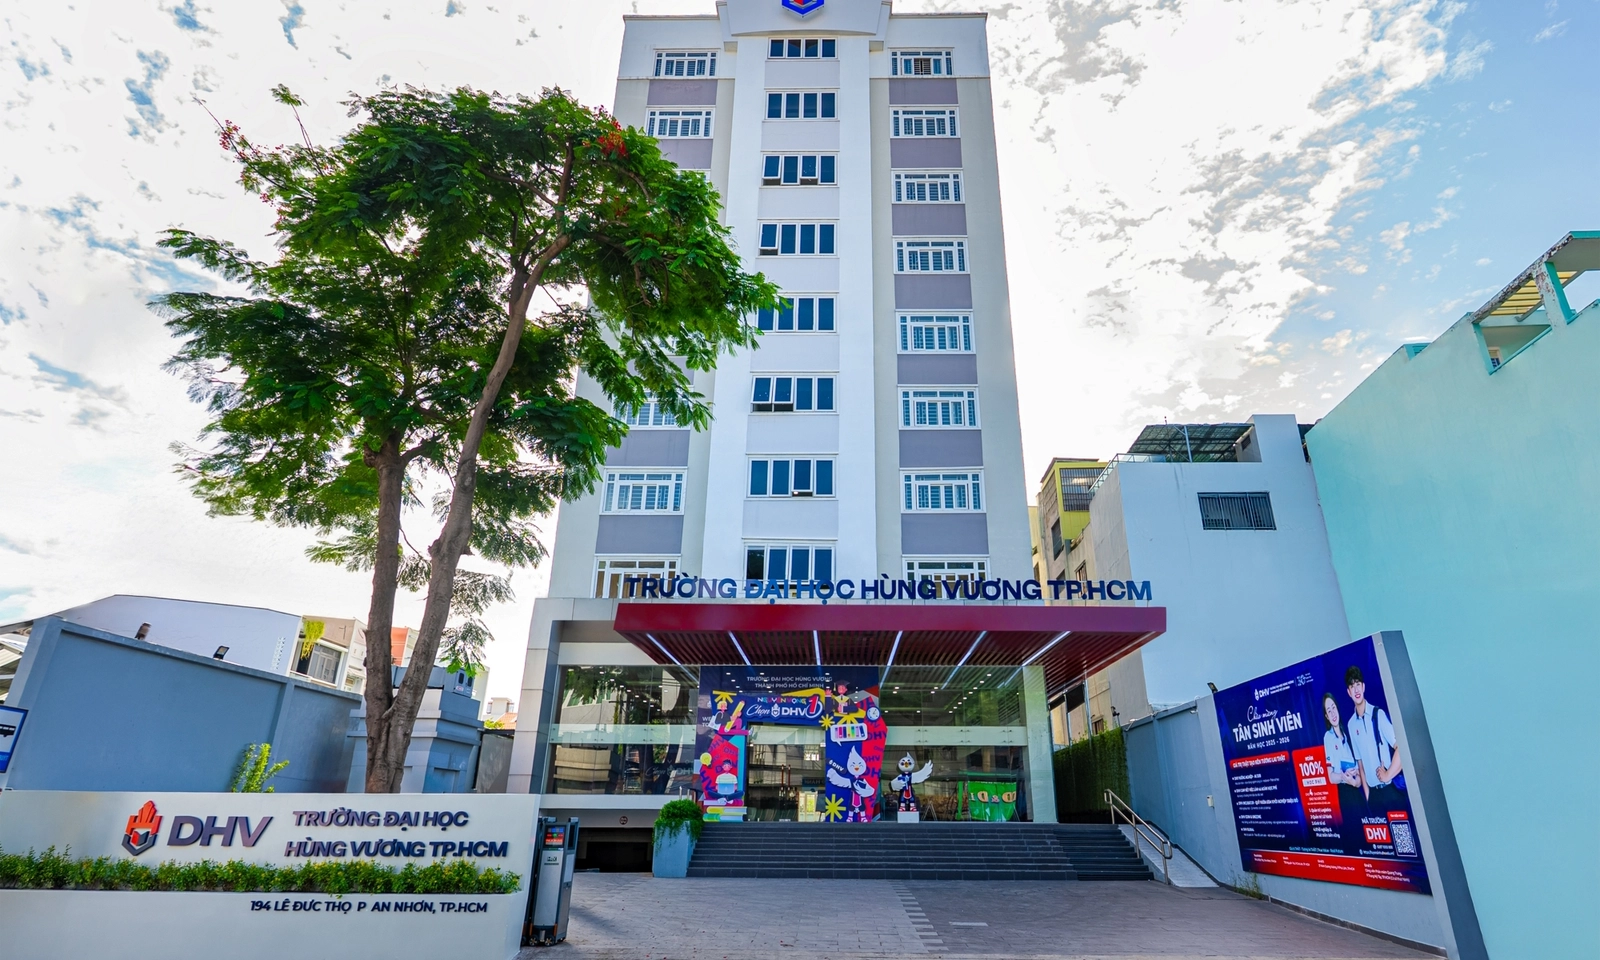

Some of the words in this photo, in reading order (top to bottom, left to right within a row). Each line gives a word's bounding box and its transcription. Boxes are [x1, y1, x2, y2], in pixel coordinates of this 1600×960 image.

[625, 572, 738, 599] TRƯỜNG
[744, 578, 788, 605] ĐẠI
[796, 578, 855, 605] HỌC
[861, 573, 937, 600] HÙNG
[941, 577, 1043, 600] VƯƠNG
[1047, 579, 1153, 600] TP.HCM
[795, 674, 811, 682] HÙNG
[1259, 688, 1270, 698] DHV
[782, 707, 807, 716] DHV
[1232, 723, 1252, 742] TÂN
[1252, 718, 1276, 739] SINH
[1276, 710, 1303, 733] VIÊN
[1299, 761, 1324, 777] 100%
[292, 805, 380, 827] TRƯỜNG
[383, 810, 419, 832] ĐẠI
[422, 810, 469, 832] HỌC
[1362, 816, 1369, 824] MÃ
[167, 815, 273, 847] DHV
[1365, 827, 1386, 840] DHV
[284, 836, 346, 858] HÙNG
[351, 838, 426, 858] VƯƠNG
[430, 840, 509, 859] TP.HCM
[250, 900, 272, 912] 194
[274, 898, 290, 912] LÊ
[324, 900, 352, 915] THỌ
[356, 901, 366, 912] P
[371, 901, 391, 912] AN
[394, 899, 436, 914] NHƠN,
[439, 901, 488, 913] TP.HCM
